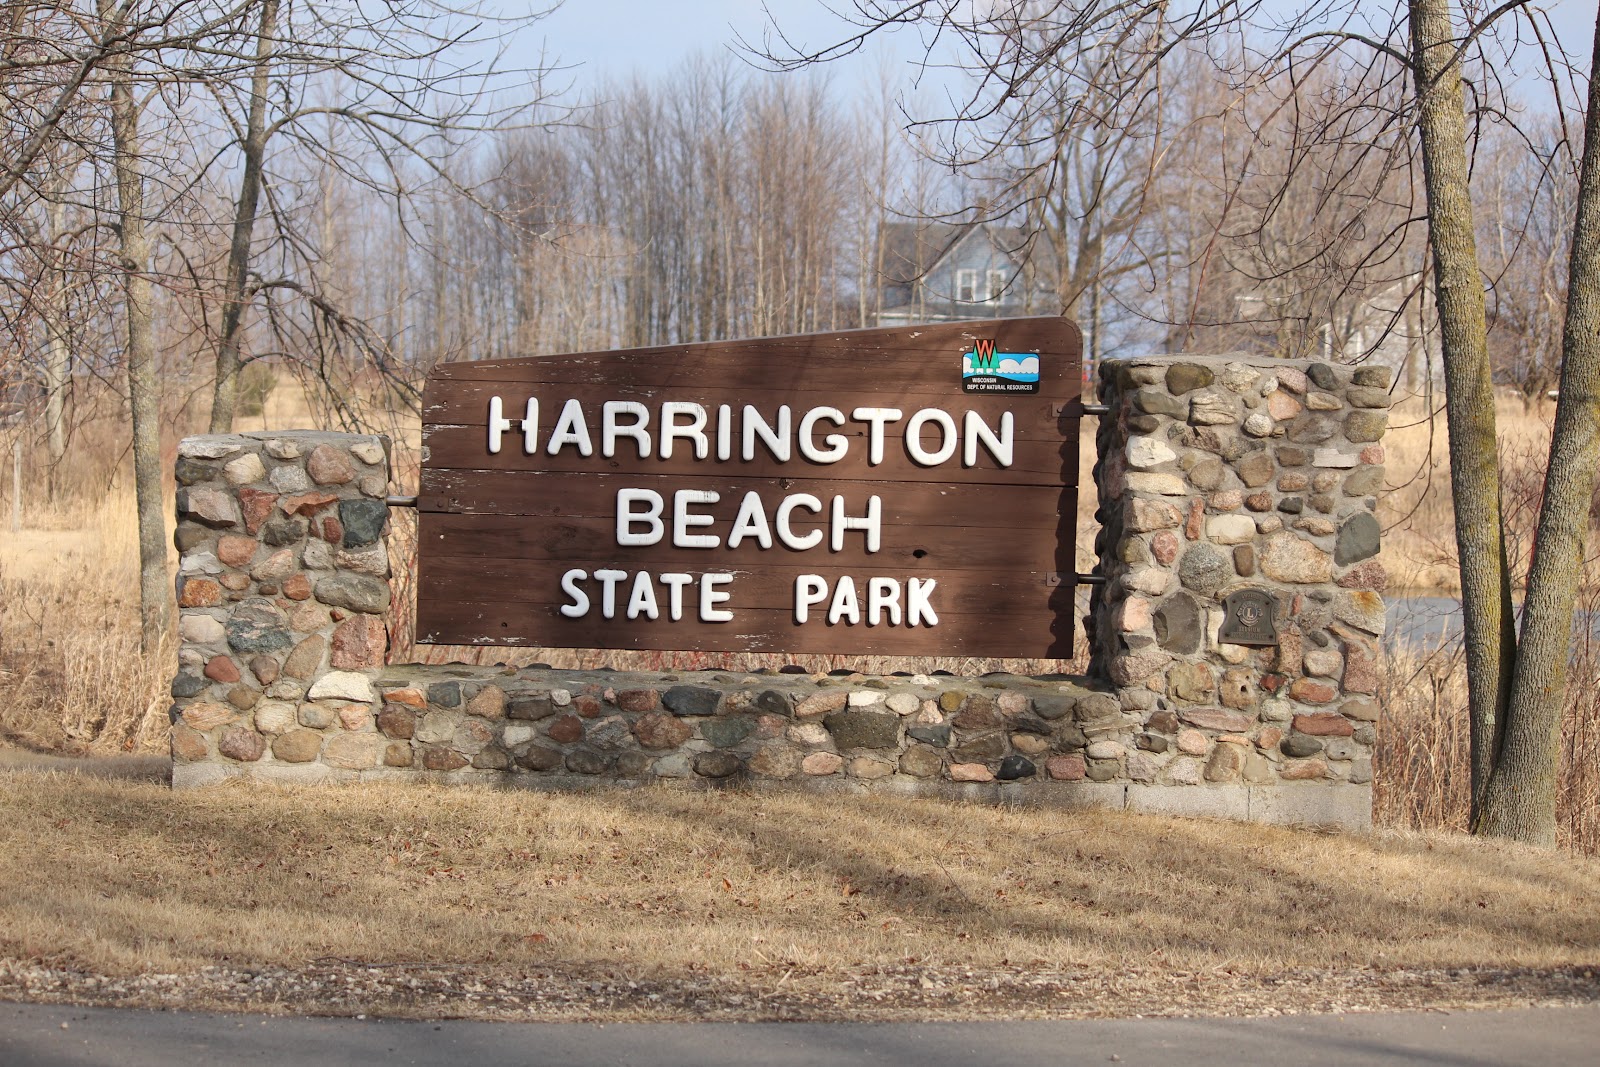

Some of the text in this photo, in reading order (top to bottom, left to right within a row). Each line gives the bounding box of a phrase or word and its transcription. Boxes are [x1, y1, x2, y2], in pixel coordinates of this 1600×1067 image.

[975, 339, 996, 362] W
[488, 395, 1015, 468] HARRINGTON
[616, 487, 883, 554] BEACH
[560, 568, 939, 627] STATE PARK
